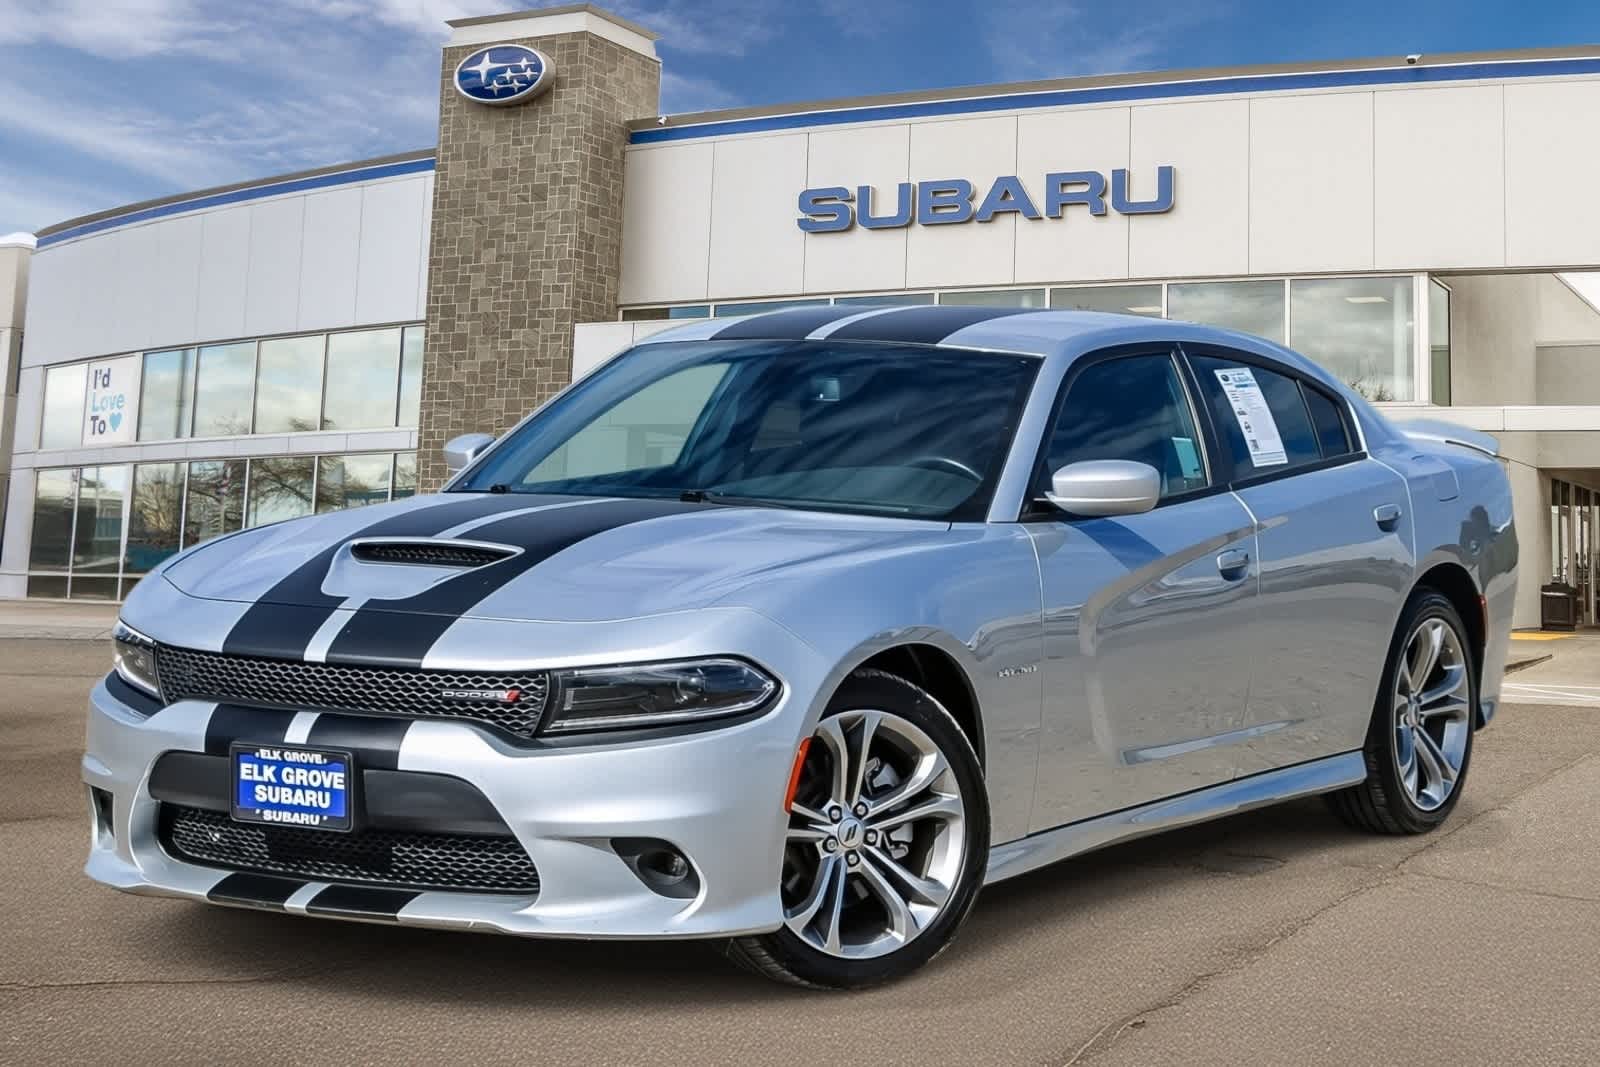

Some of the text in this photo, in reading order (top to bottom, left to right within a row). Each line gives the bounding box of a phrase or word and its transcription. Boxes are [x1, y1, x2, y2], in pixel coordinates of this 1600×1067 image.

[797, 165, 1176, 233] SUBARU
[94, 368, 111, 389] I'd
[92, 392, 125, 412] Love
[91, 415, 106, 435] To
[259, 749, 322, 764] ELK GROVE
[240, 763, 345, 790] ELK GROVE
[254, 784, 331, 809] SUBARU
[263, 809, 320, 825] SUBARU
